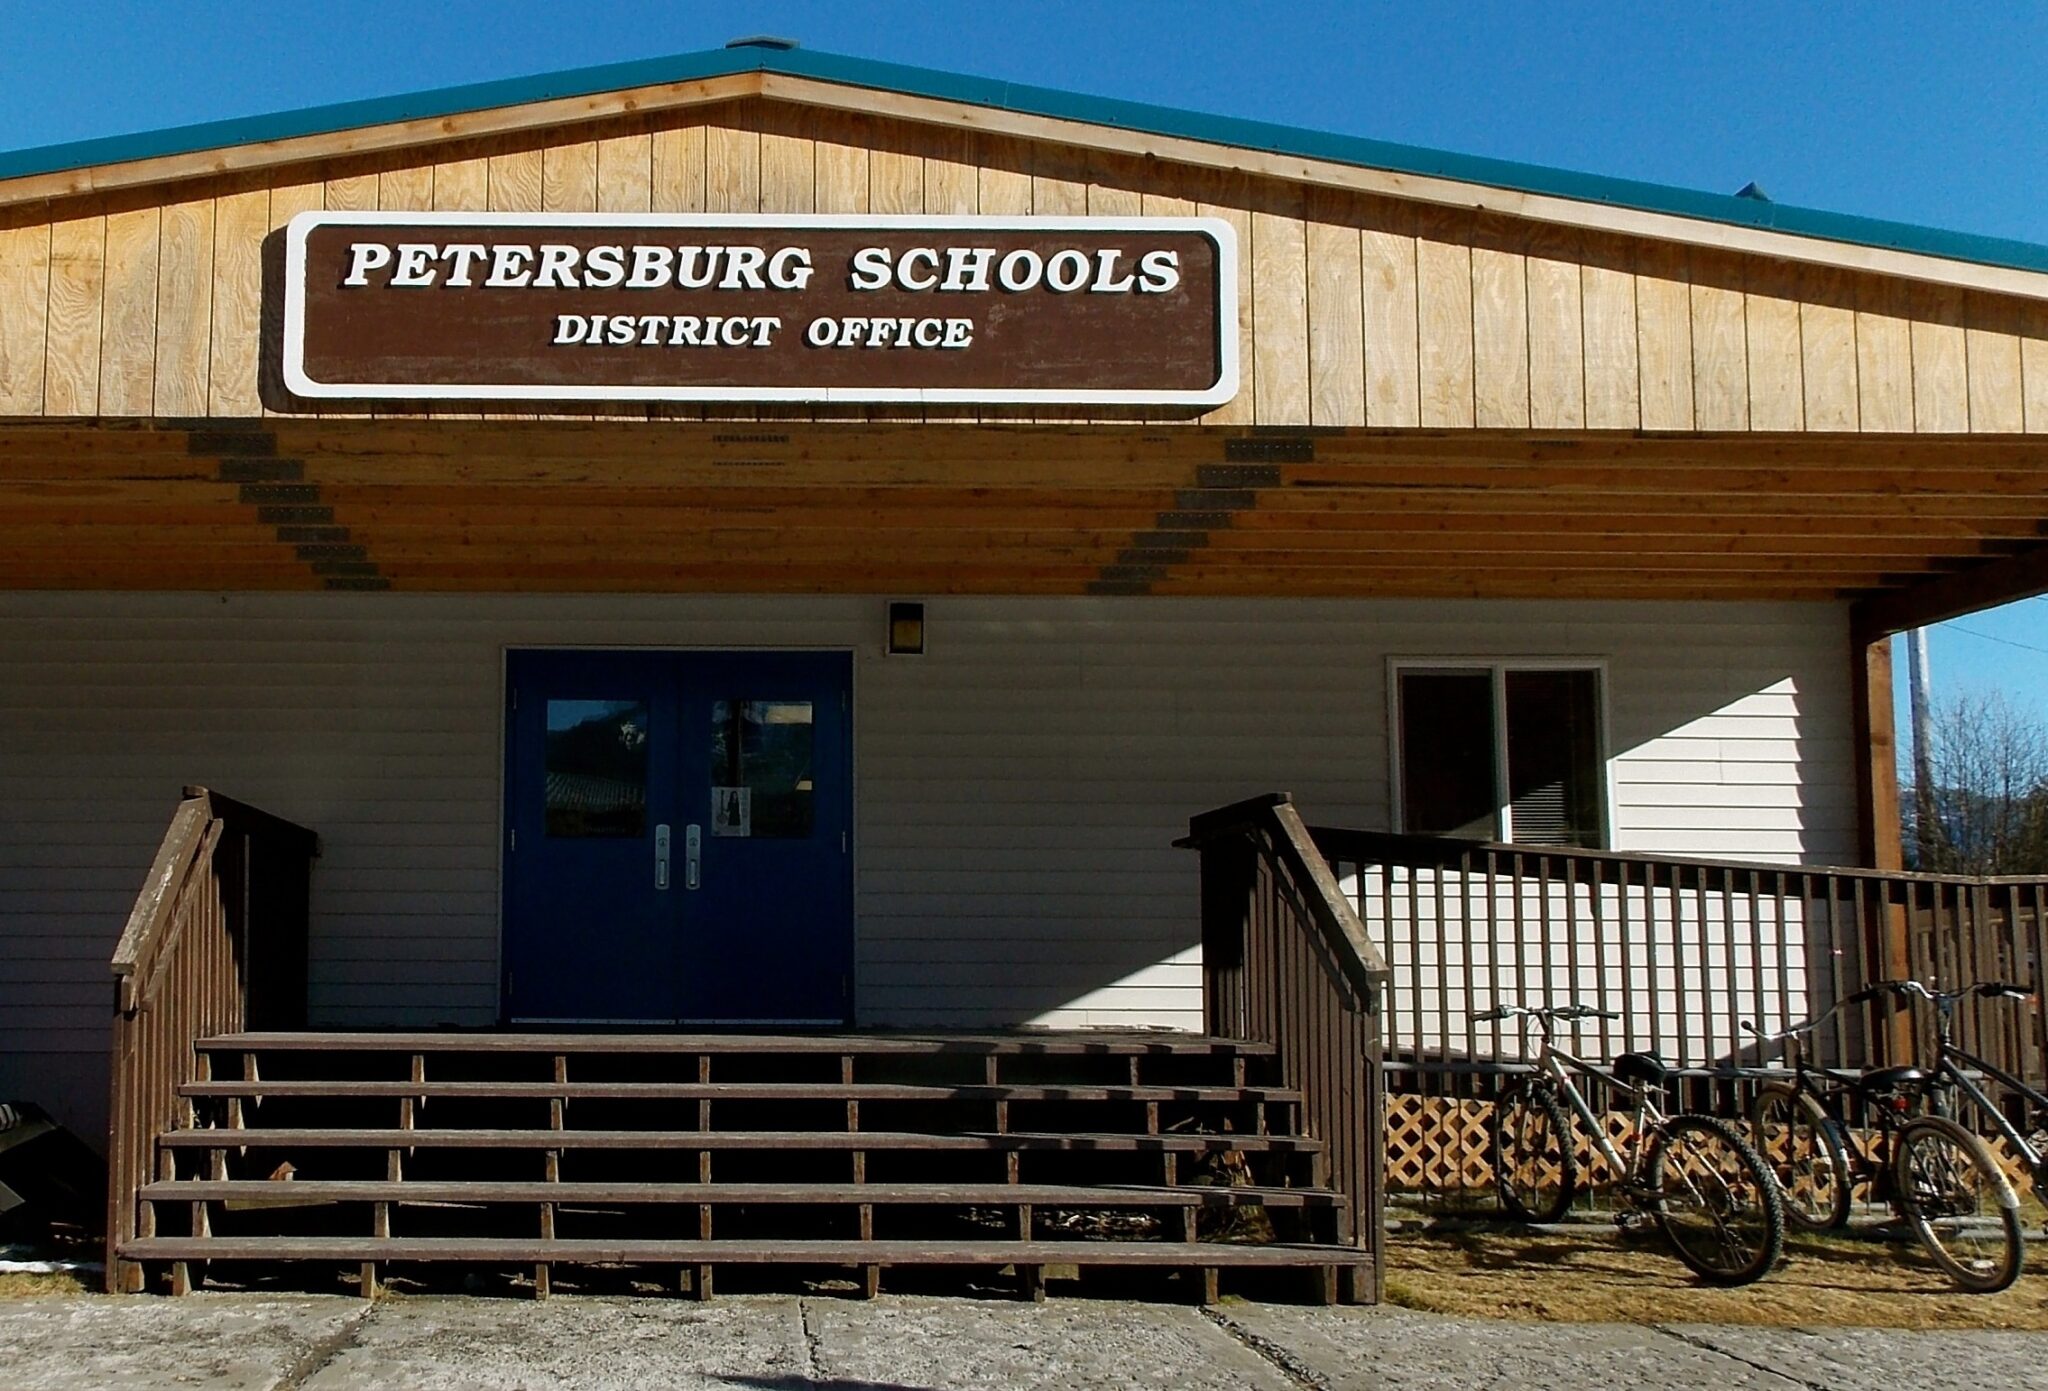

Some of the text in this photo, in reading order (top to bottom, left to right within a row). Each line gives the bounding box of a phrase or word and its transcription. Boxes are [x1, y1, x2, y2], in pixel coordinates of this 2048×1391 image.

[343, 243, 1181, 293] PETERSBURG SCHOOLS
[553, 314, 974, 348] DISTRICT OFFICE
